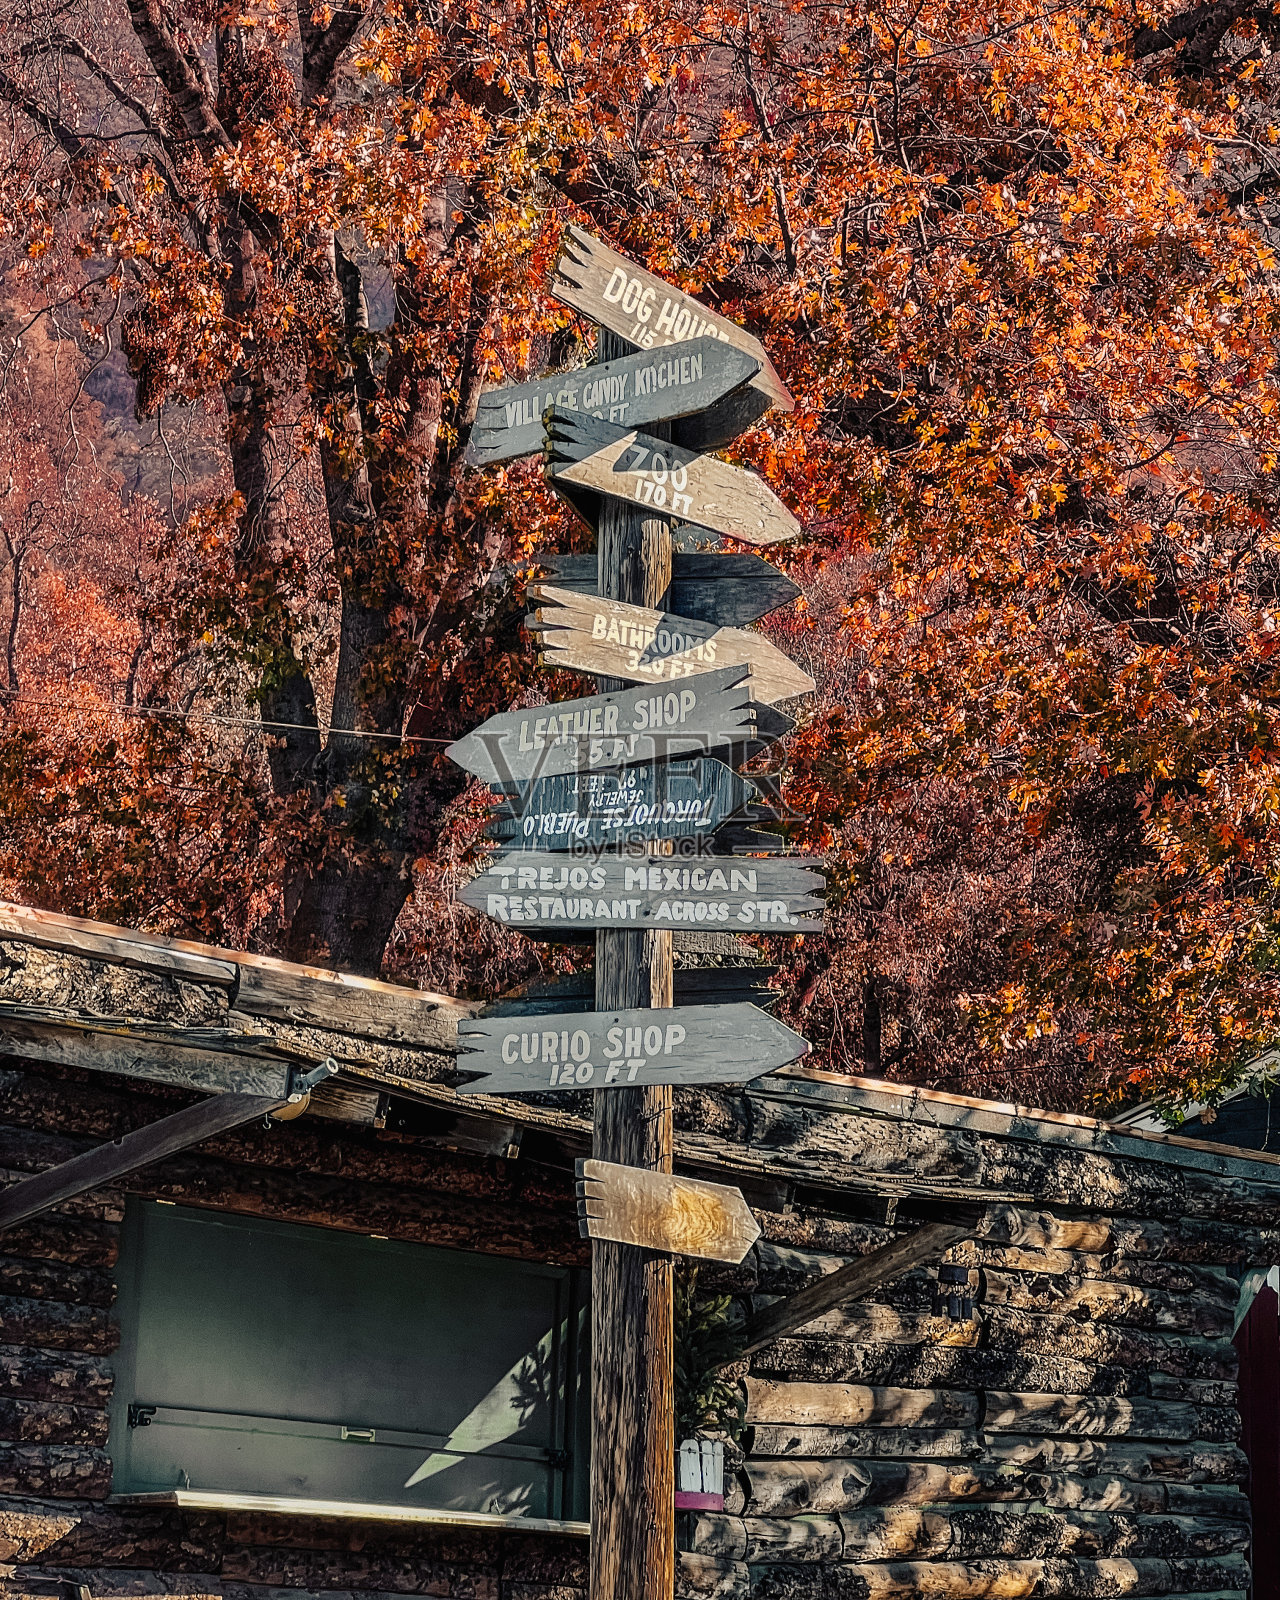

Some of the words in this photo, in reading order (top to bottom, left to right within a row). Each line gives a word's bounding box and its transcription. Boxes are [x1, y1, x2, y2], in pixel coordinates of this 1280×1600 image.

[602, 266, 656, 323] DOG
[583, 373, 628, 409] CANDY
[629, 446, 688, 493] ZOO
[634, 479, 666, 507] 170
[672, 489, 694, 515] FT
[591, 614, 718, 663] BATHROOMS
[624, 650, 665, 675] 320
[670, 659, 695, 679] FT
[519, 704, 619, 752] LEATHER
[632, 689, 697, 731] SHOP
[588, 788, 644, 809] JEWELRY
[601, 799, 712, 831] TURQUOISE
[523, 810, 592, 839] PUEBLO
[488, 866, 606, 891] TREJOS
[624, 868, 758, 893] MEXICAN
[487, 894, 641, 923] RESTAURANT
[654, 900, 729, 921] ACROSS
[737, 901, 799, 926] STR.
[501, 1030, 591, 1064] CURIO
[603, 1024, 686, 1058] SHOP
[549, 1062, 595, 1086] 120
[604, 1058, 647, 1083] FT
